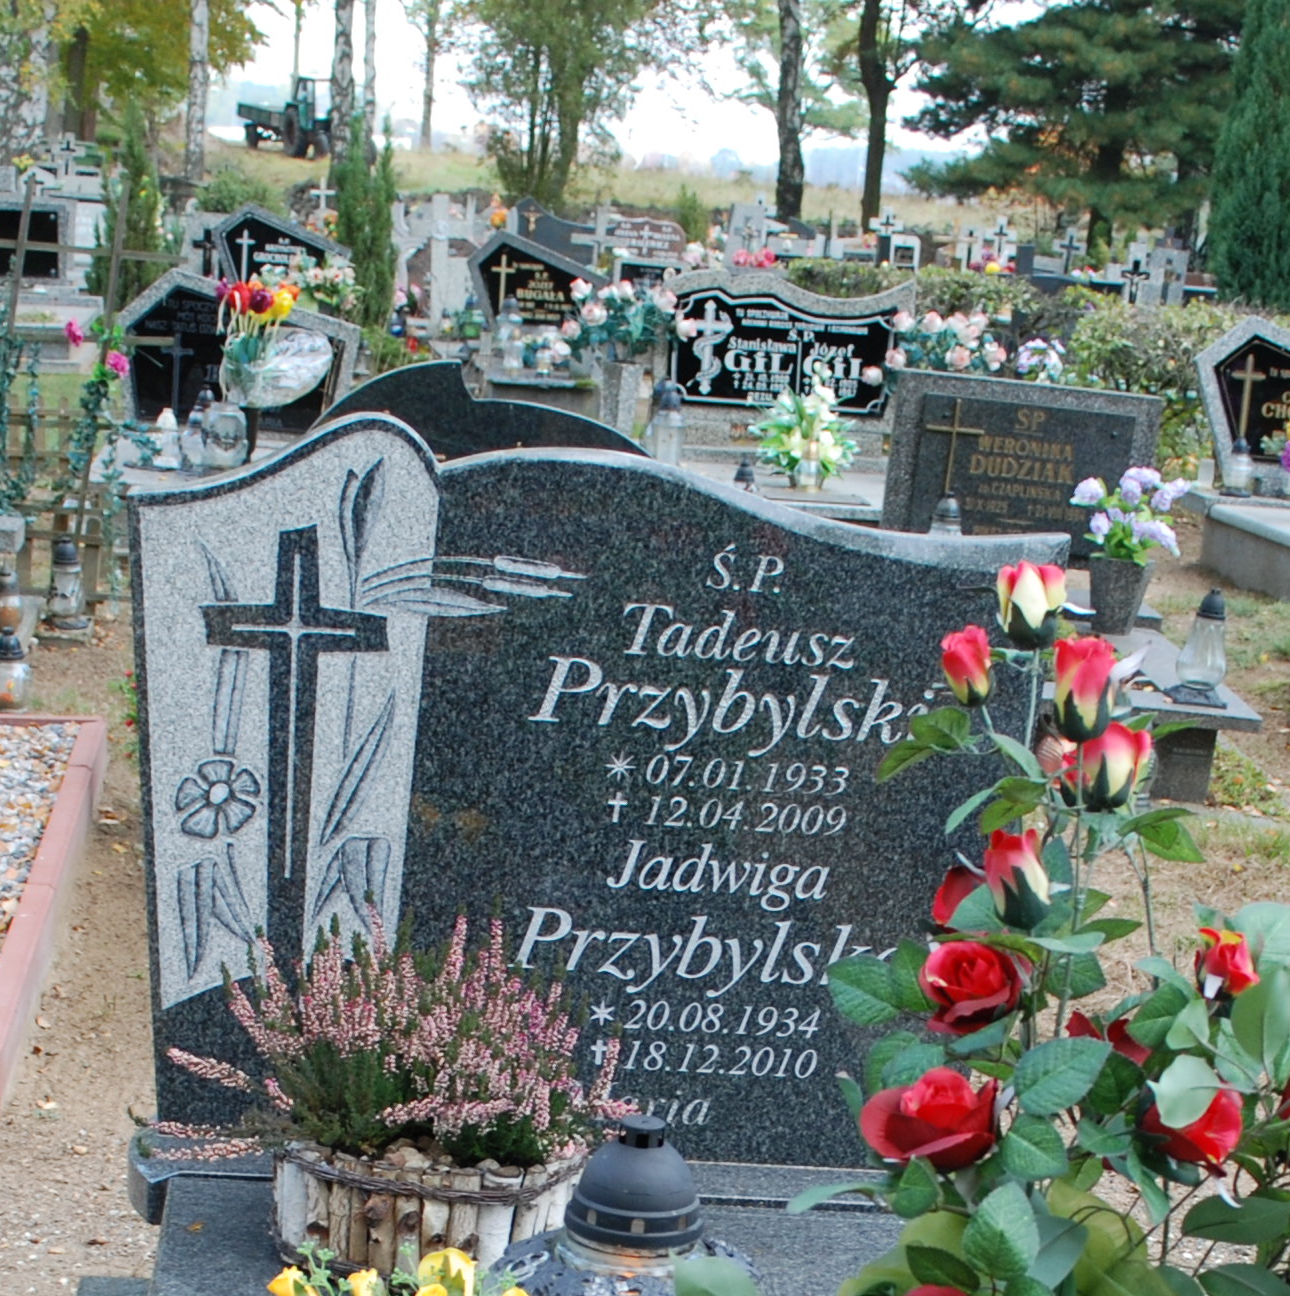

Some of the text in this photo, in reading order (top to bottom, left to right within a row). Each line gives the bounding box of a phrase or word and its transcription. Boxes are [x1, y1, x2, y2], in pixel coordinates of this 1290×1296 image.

[970, 453, 1075, 485] DUDZIAK
[705, 544, 785, 596] Ś.P.
[621, 601, 857, 672] Tadeusz
[645, 753, 850, 797] 07.01.1933
[643, 794, 848, 836] 12.04.2009
[606, 839, 831, 912] Jadwiga
[623, 1000, 821, 1039] 20.08.1934
[621, 1040, 819, 1079] 18.12.2010
